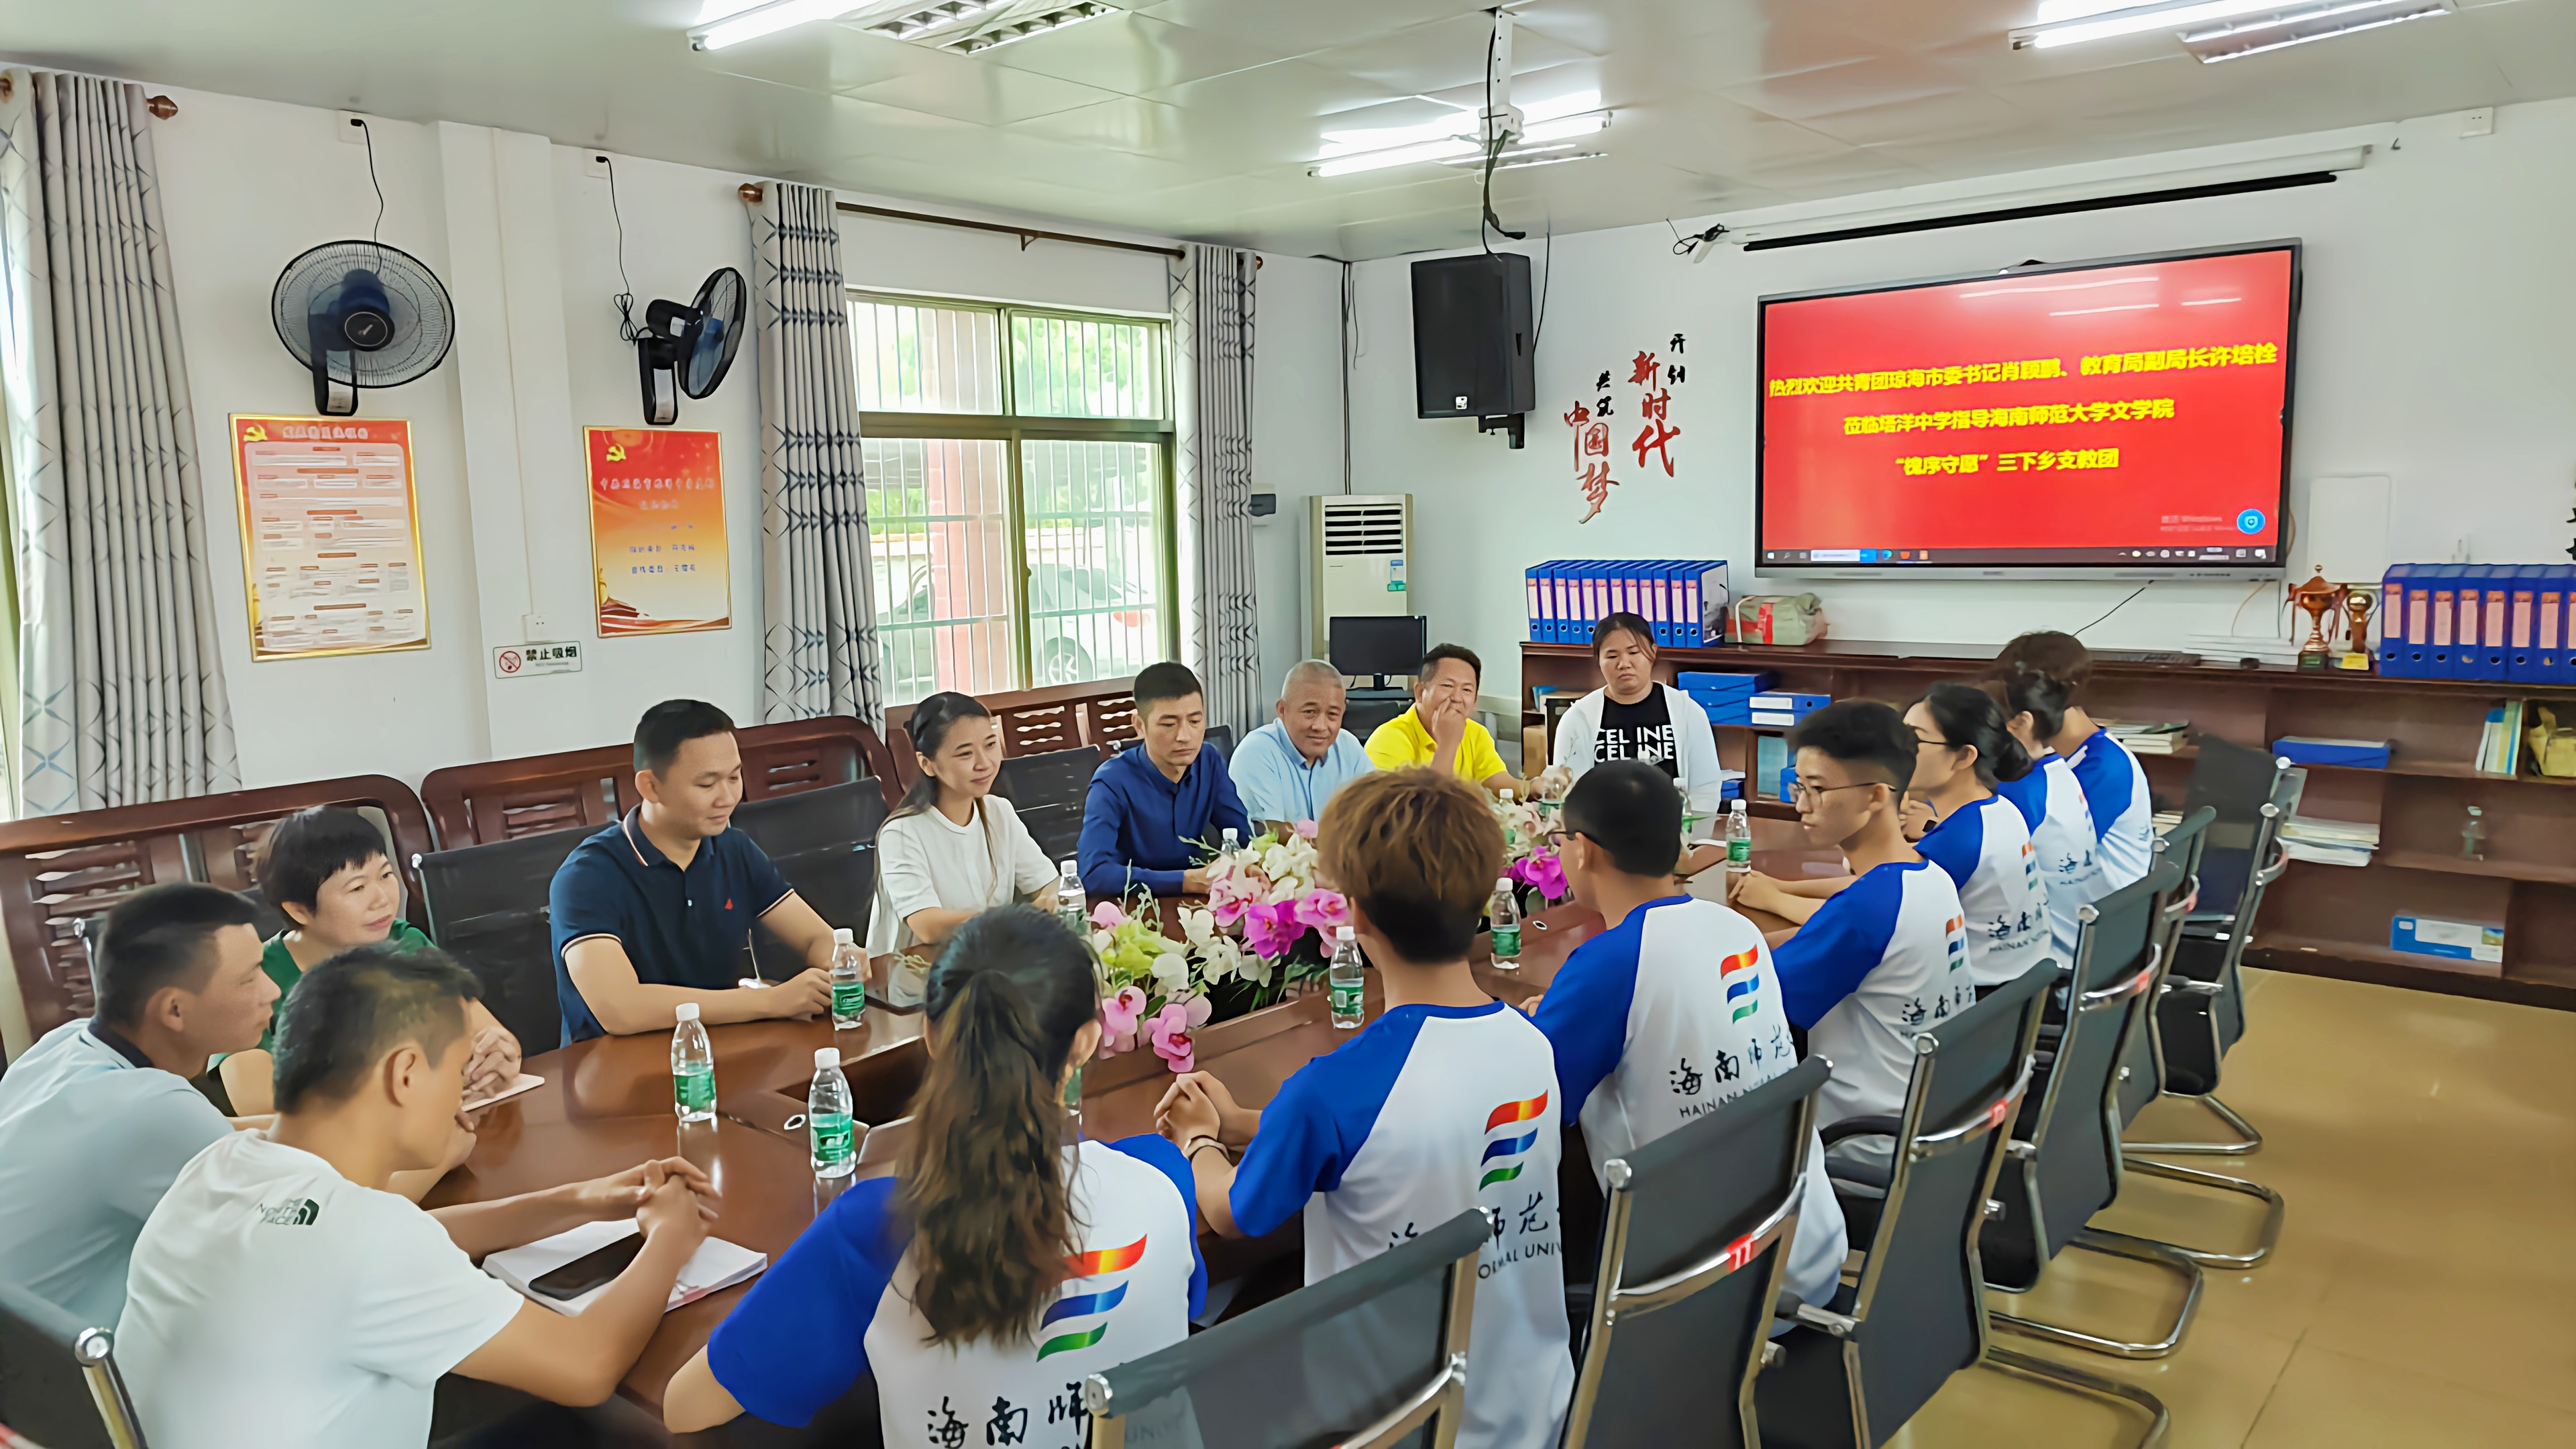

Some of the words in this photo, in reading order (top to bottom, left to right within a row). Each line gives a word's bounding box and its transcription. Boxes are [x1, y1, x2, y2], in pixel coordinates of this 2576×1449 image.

[1628, 351, 1680, 478] 新时代
[1843, 398, 2175, 435] 莅临塔洋中学指导海南师范大学文学院
[1564, 400, 1620, 525] 中国梦
[526, 646, 577, 661] 禁止吸烟
[1670, 1024, 1793, 1095] 海南师范
